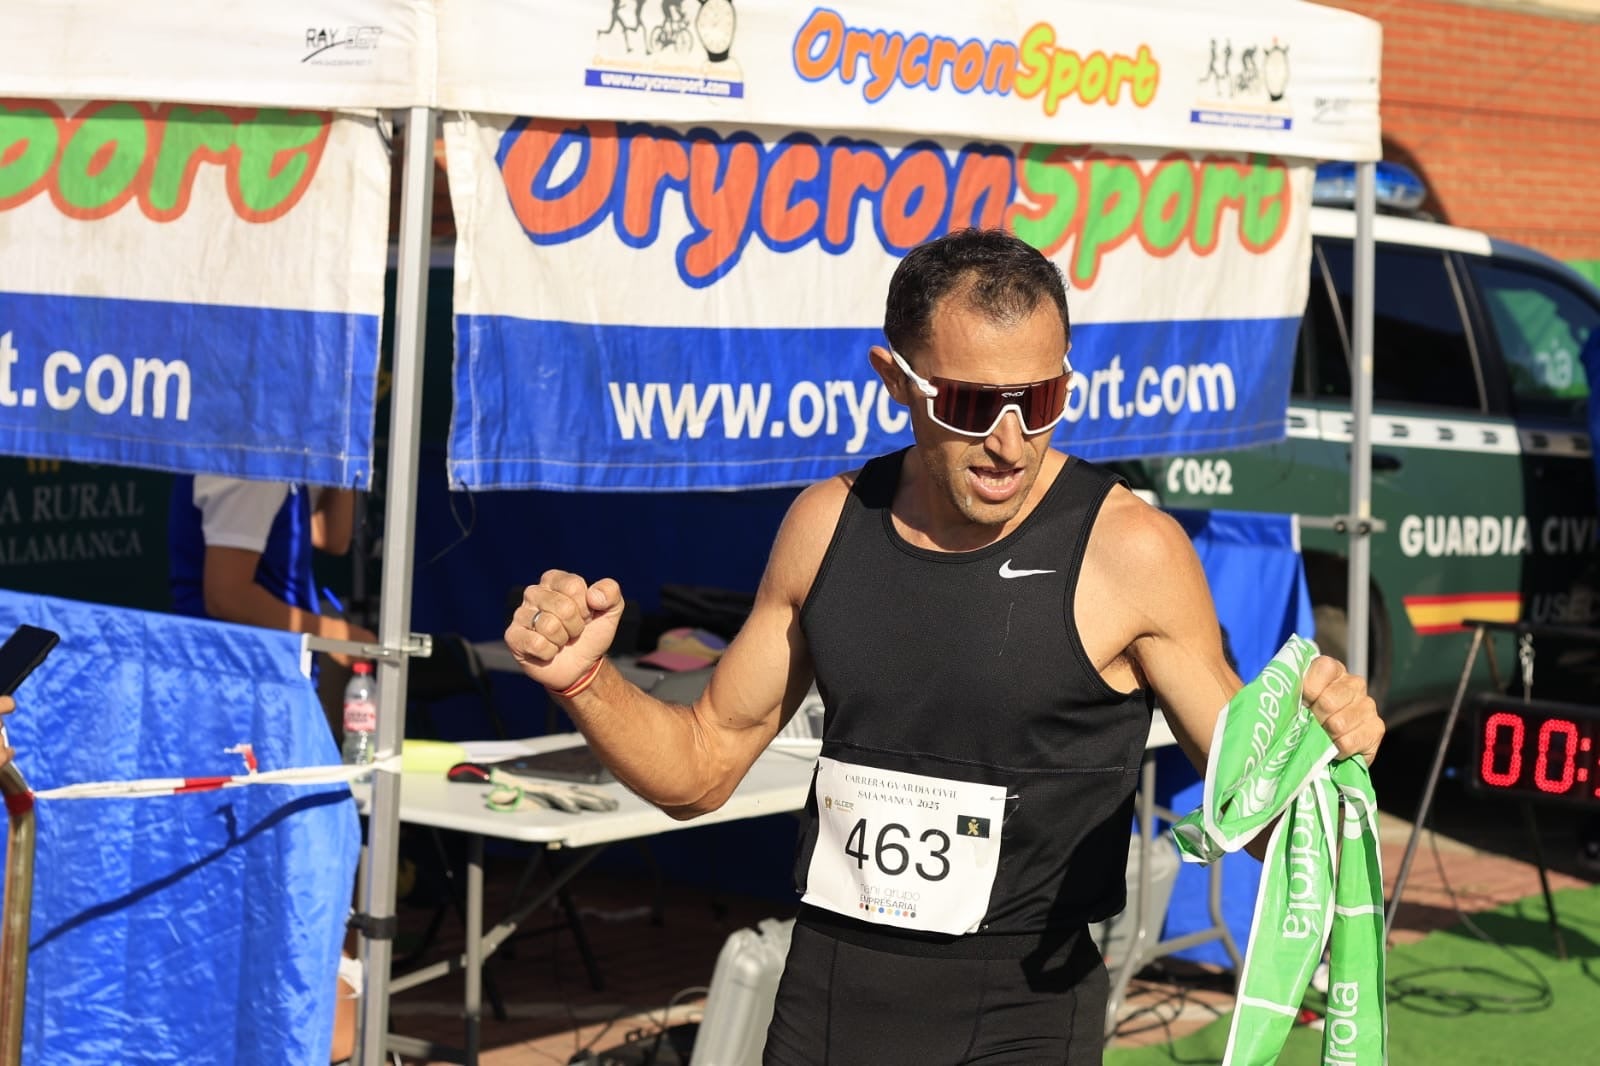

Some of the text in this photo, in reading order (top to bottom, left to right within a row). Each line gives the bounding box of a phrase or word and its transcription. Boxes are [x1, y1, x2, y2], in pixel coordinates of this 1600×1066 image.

[793, 7, 1160, 117] OrycronSport
[32, 481, 145, 523] RURAL
[1400, 514, 1533, 557] GUARDIA
[1482, 712, 1600, 798] 00:
[844, 774, 885, 789] CARRERA
[932, 787, 959, 800] CIVIL
[857, 789, 941, 811] SALAMANCA 2025
[845, 818, 951, 882] 463
